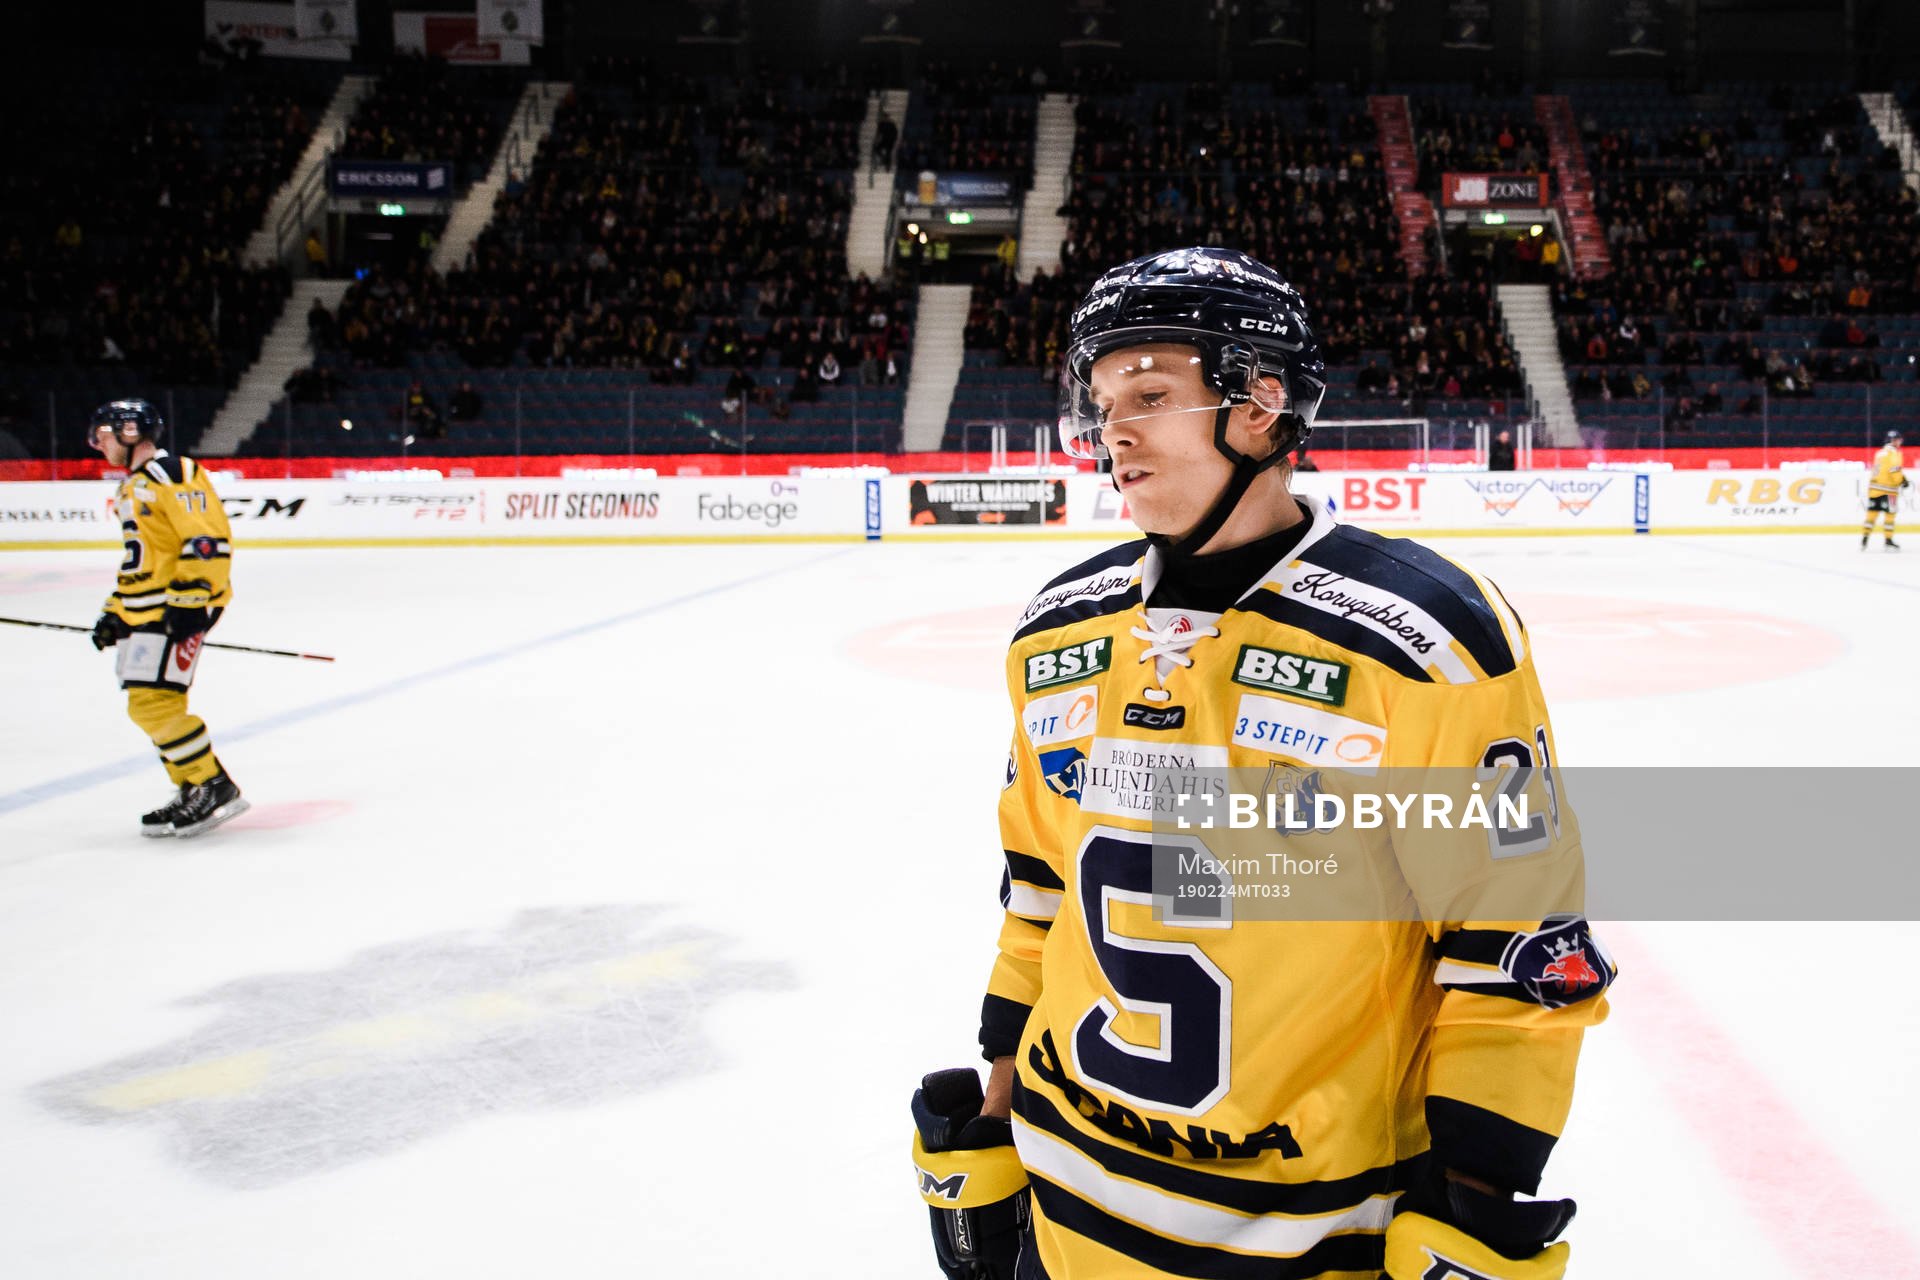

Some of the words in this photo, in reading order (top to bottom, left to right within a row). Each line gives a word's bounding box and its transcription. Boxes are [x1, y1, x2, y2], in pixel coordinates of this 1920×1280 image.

[337, 171, 418, 187] ERICSSON
[1490, 183, 1538, 198] ZONE
[1077, 293, 1120, 323] CCM
[1240, 318, 1288, 335] CCM
[176, 490, 207, 513] 77
[1344, 478, 1426, 511] BST
[1706, 478, 1826, 504] RBG
[60, 509, 98, 521] SPEL
[221, 497, 306, 518] CM
[505, 494, 560, 520] SPLIT
[565, 492, 660, 520] SECONDS
[699, 495, 798, 528] Fabege
[1731, 507, 1799, 516] SCHAKT
[1292, 571, 1436, 655] Korvgubbens
[1028, 638, 1106, 686] BST
[1238, 648, 1340, 695] BST
[1125, 708, 1182, 726] CCM
[1235, 717, 1249, 736] 3
[1117, 790, 1176, 813] MÅLERI
